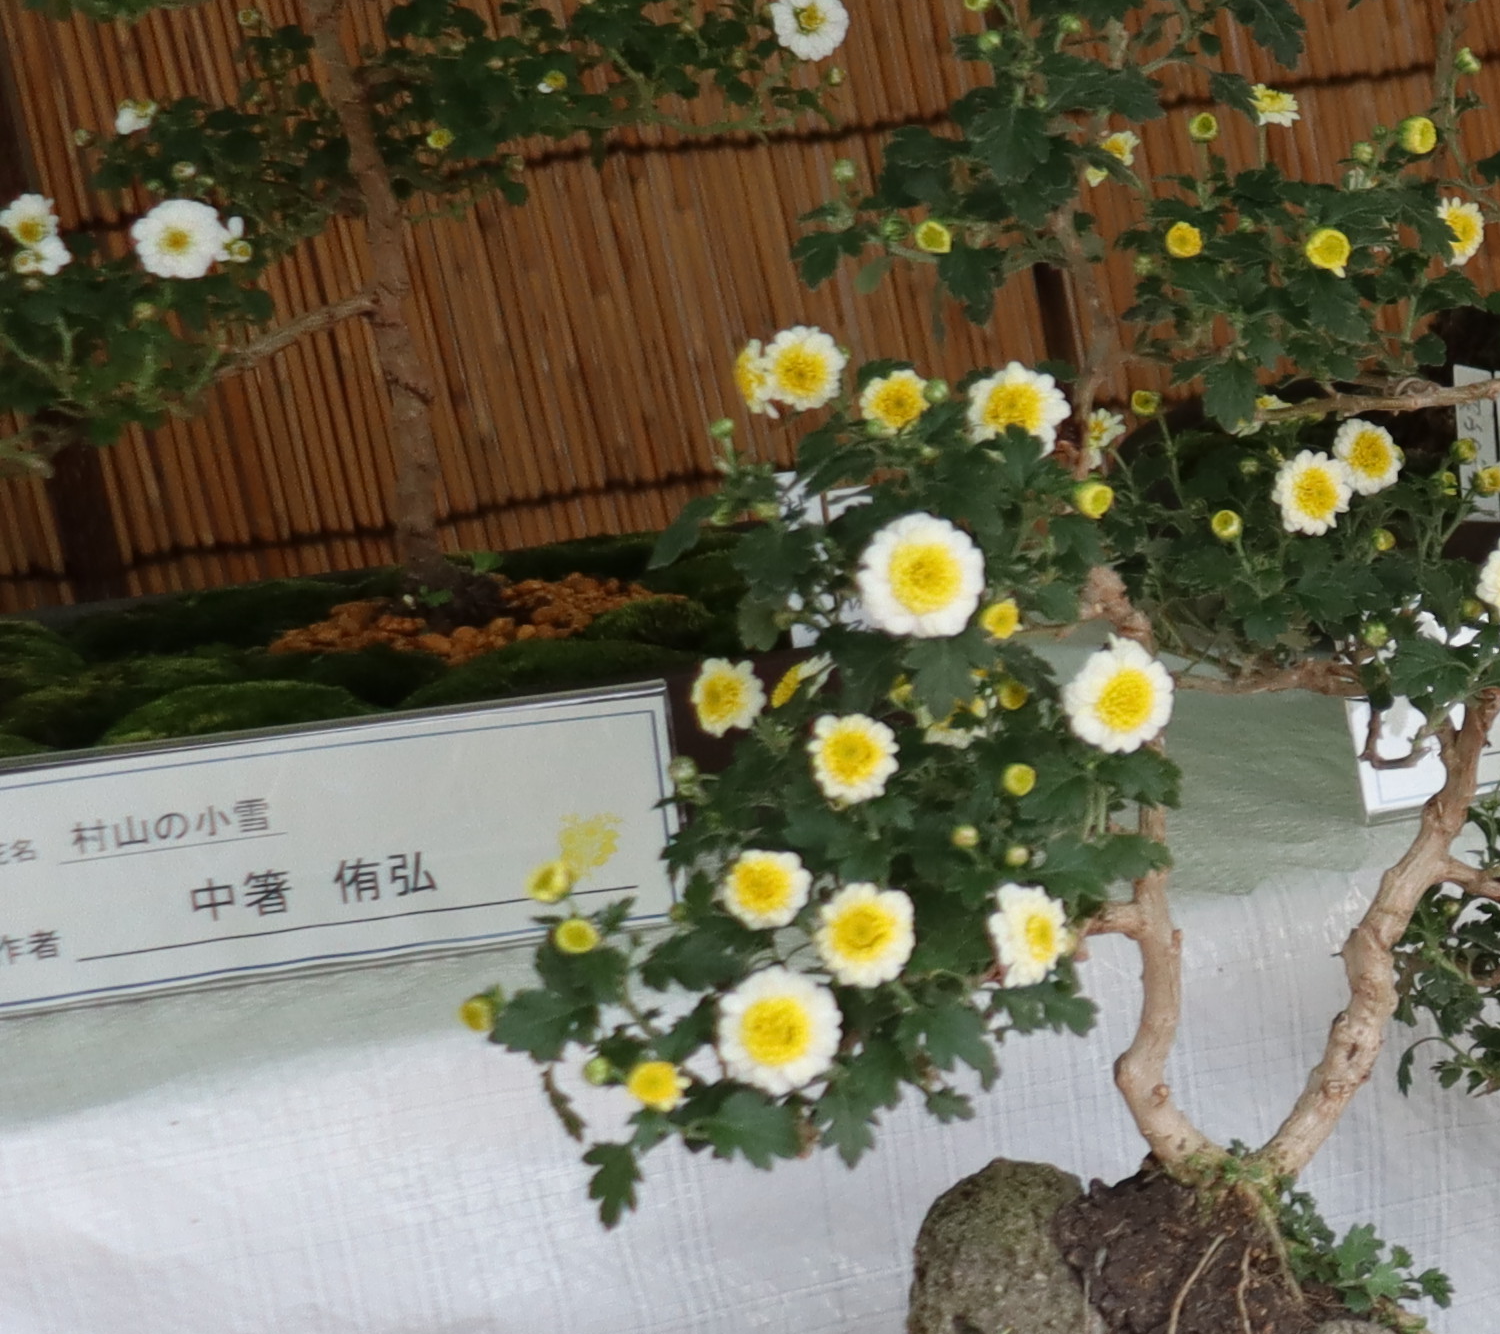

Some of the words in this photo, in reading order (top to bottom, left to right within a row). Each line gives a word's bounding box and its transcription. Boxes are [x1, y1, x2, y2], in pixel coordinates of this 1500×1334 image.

[70, 797, 271, 856] 村山の小雪
[190, 868, 293, 922] 中箸
[333, 851, 439, 905] 侑弘
[0, 928, 63, 965] 作者
